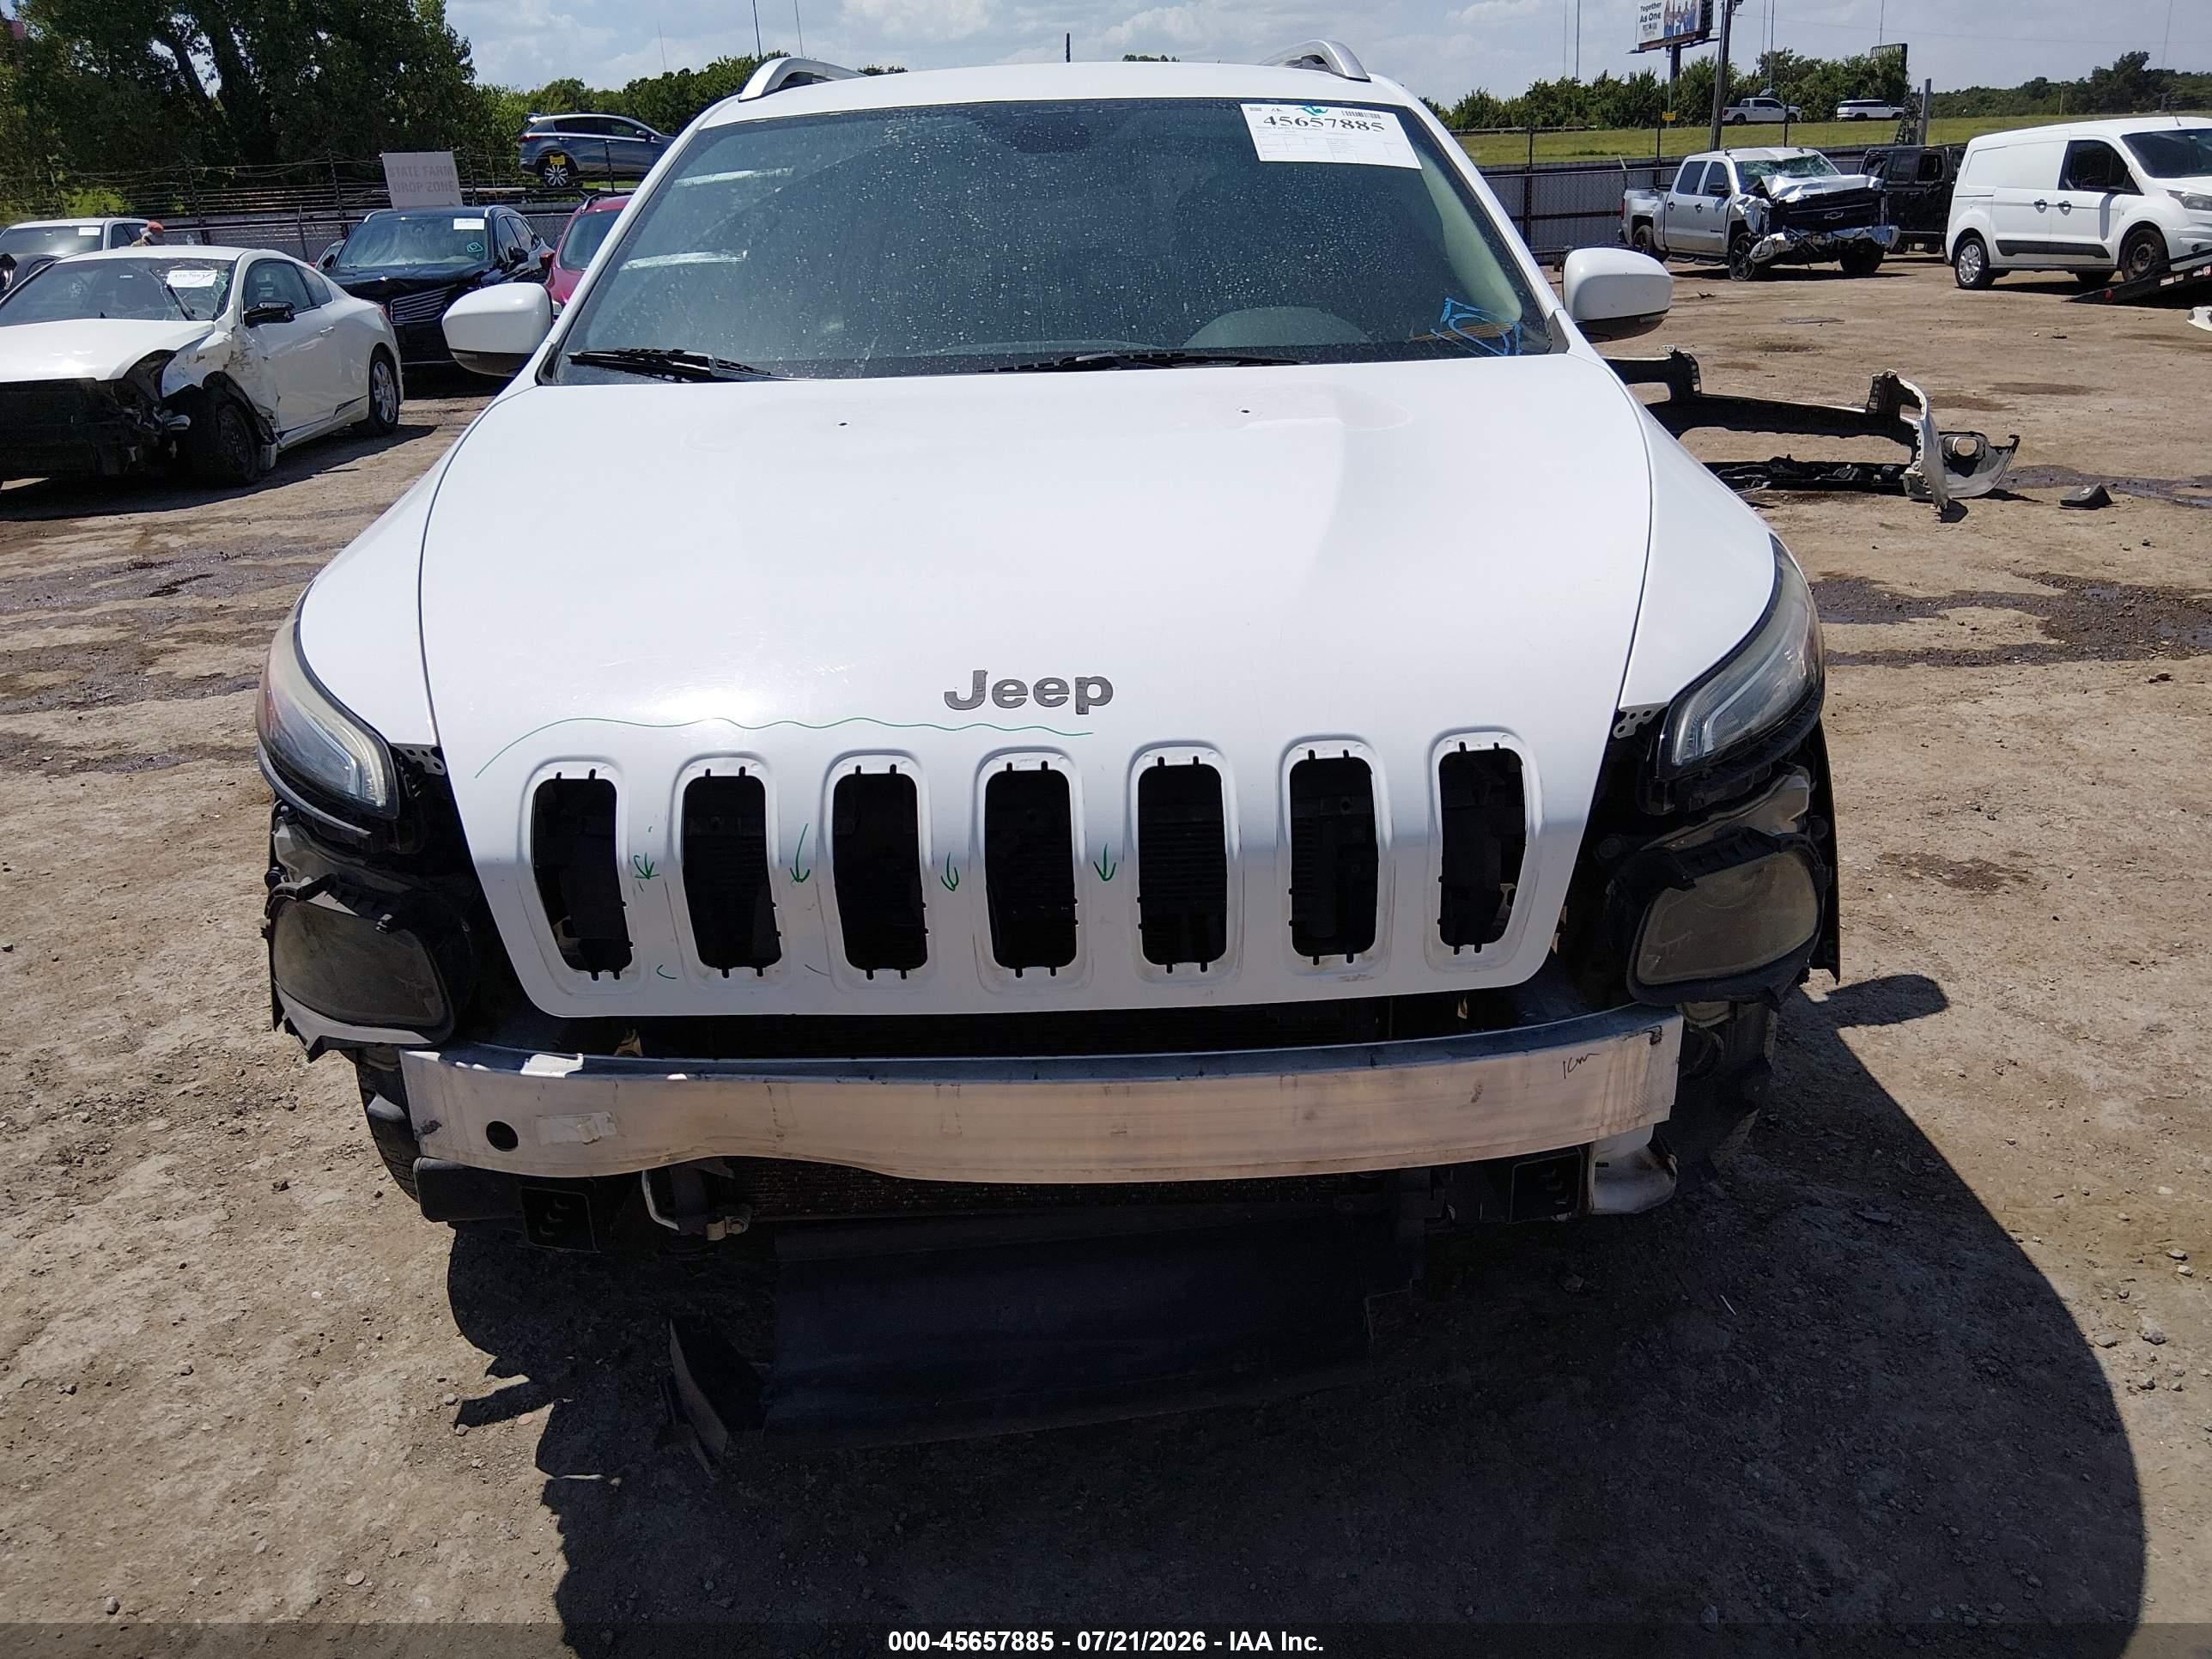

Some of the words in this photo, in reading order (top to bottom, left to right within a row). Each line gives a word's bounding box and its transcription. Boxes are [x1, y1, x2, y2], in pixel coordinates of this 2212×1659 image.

[1640, 3, 1662, 12] Together
[1263, 115, 1385, 132] 45657885
[388, 166, 419, 179] STATE
[422, 165, 454, 177] FARM
[393, 183, 423, 193] DROP
[426, 181, 456, 193] ZONE
[944, 669, 1114, 714] Jeep
